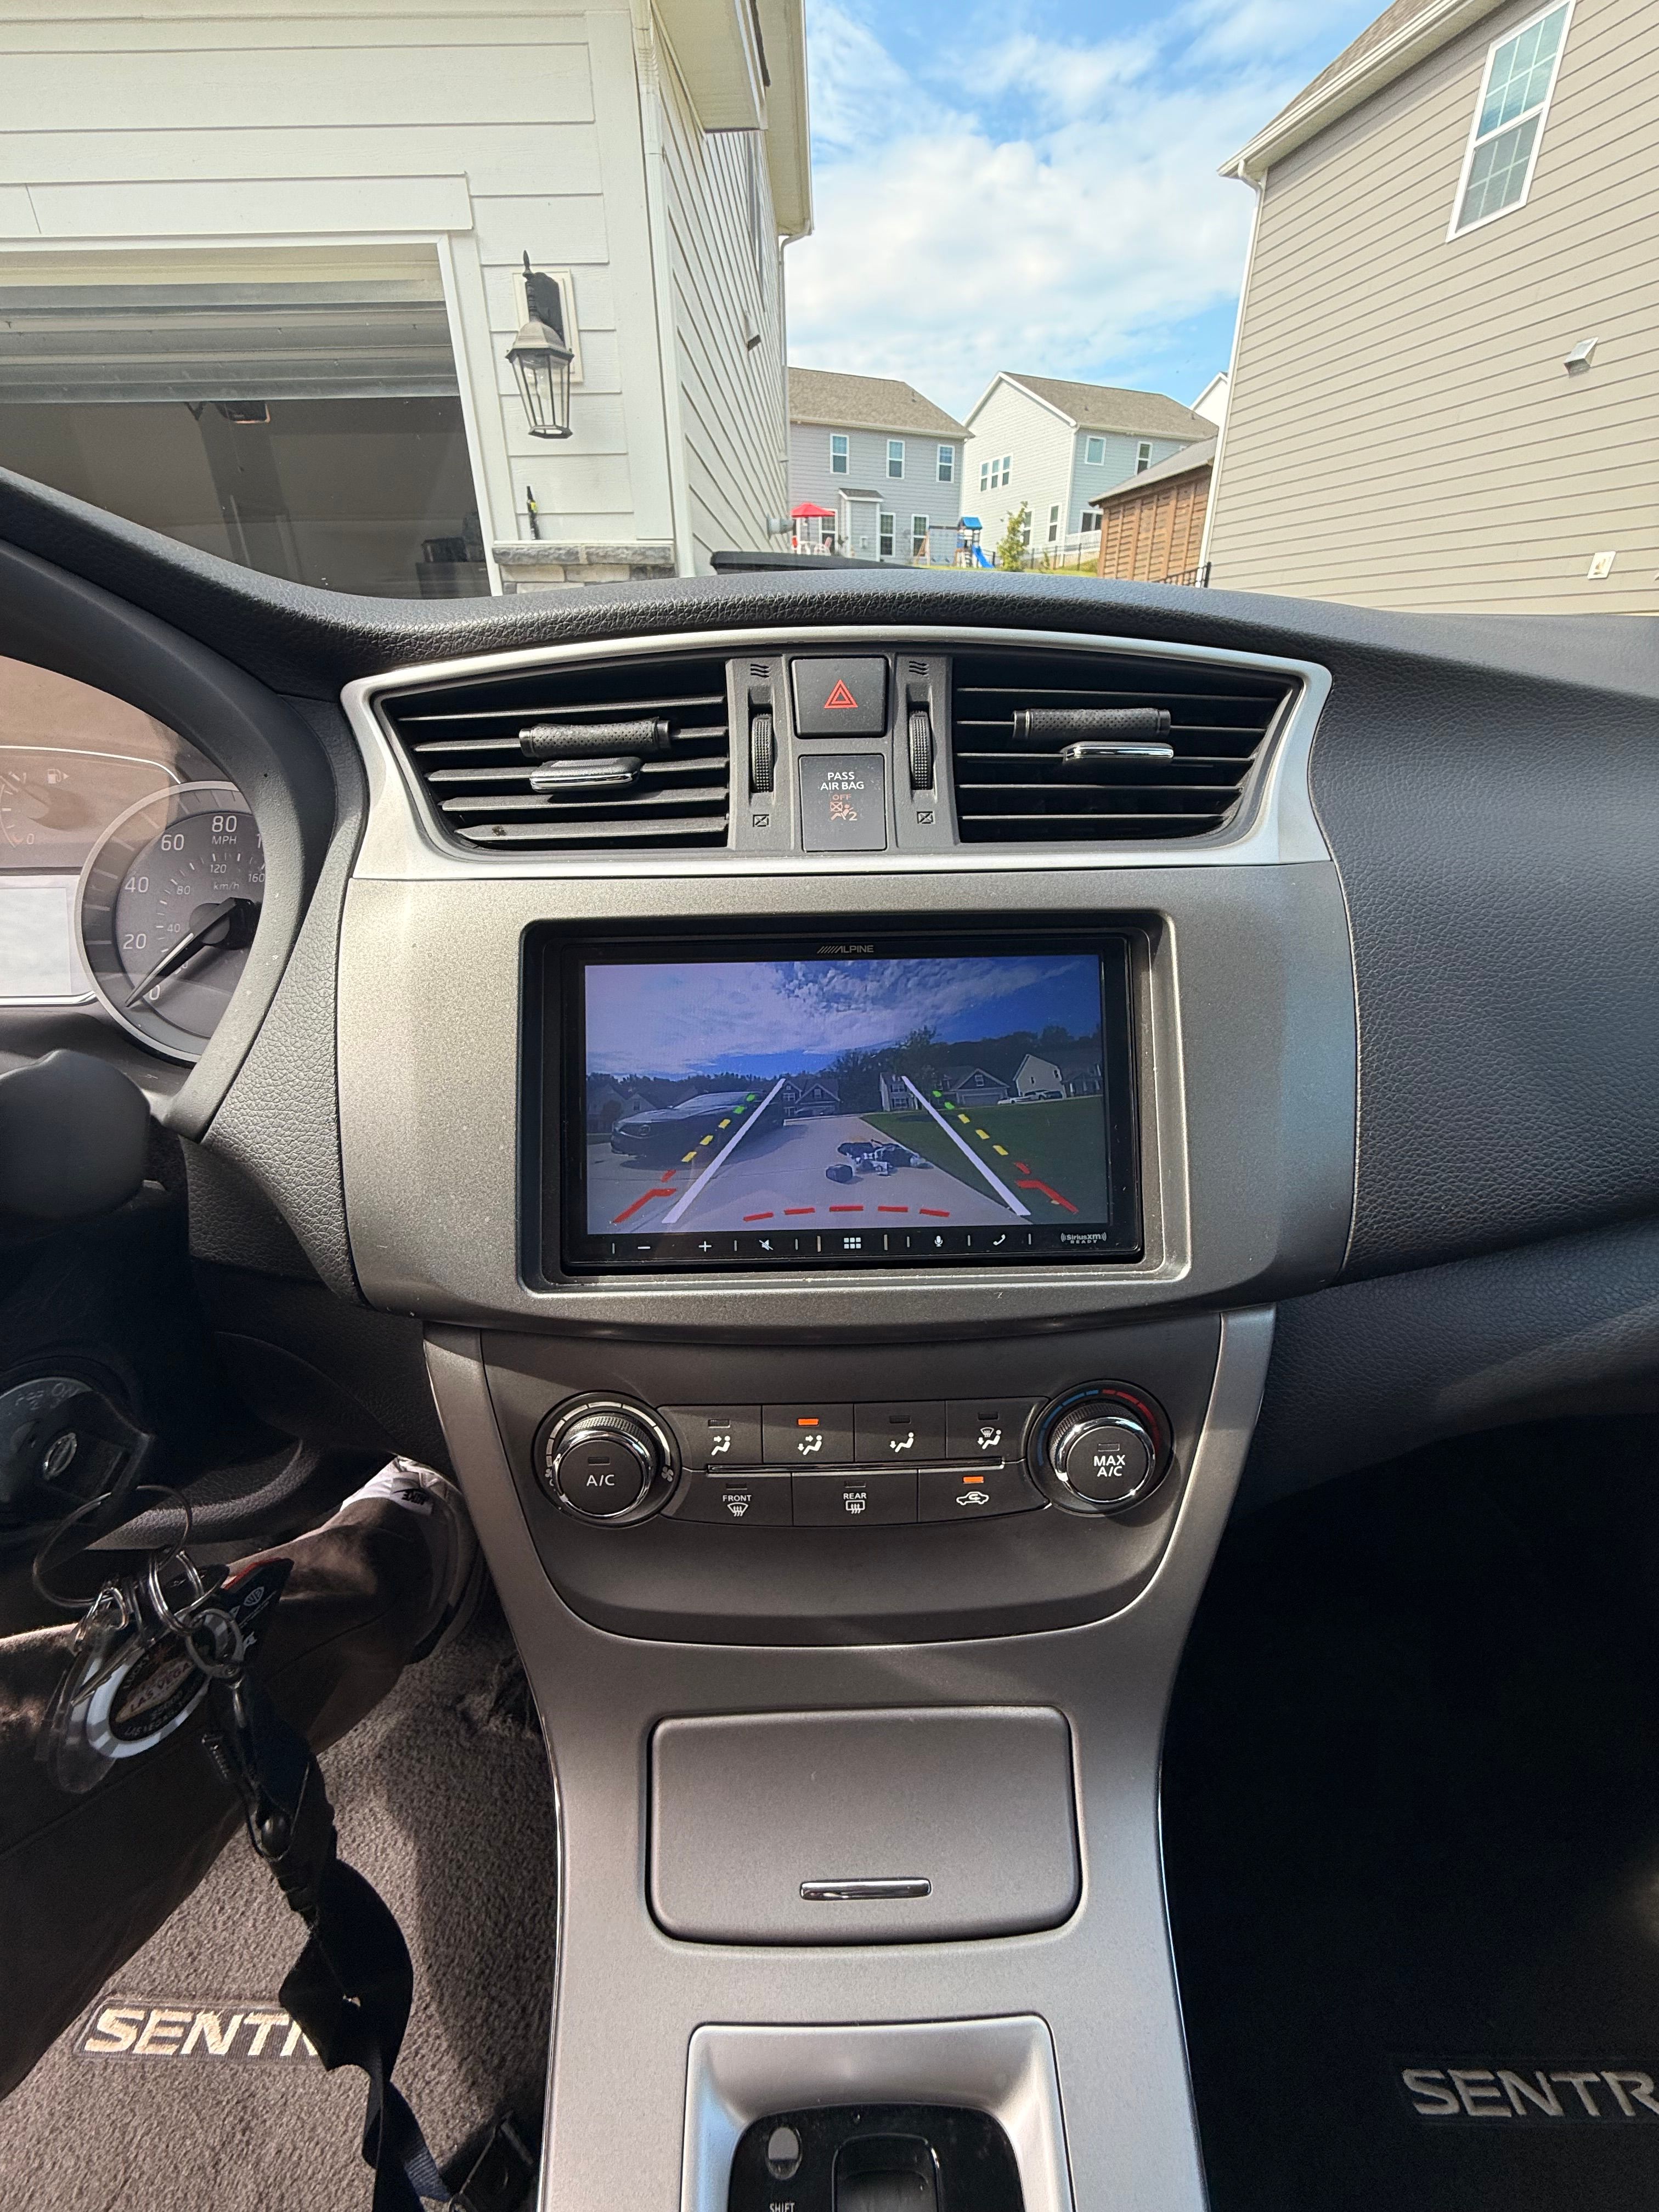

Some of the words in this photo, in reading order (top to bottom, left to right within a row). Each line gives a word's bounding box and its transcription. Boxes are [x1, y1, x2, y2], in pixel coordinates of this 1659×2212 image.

[827, 771, 855, 780] PASS
[820, 782, 839, 791] AIR
[841, 781, 865, 790] BAG
[211, 815, 237, 833] 80
[161, 834, 184, 851] 60
[211, 836, 237, 845] MPH
[210, 864, 227, 873] 120
[248, 873, 265, 883] 160
[124, 877, 149, 893] 40
[176, 885, 191, 895] 80
[213, 882, 240, 891] km/h
[167, 924, 181, 933] 40
[122, 933, 146, 949] 20
[834, 945, 874, 953] ALPINE
[149, 984, 161, 1001] 0
[1093, 1454, 1126, 1466] MAX
[1097, 1466, 1122, 1477] A/C
[586, 1474, 615, 1487] A/C
[1401, 2069, 1659, 2117] SENTR
[769, 2202, 795, 2212] SHIFT
